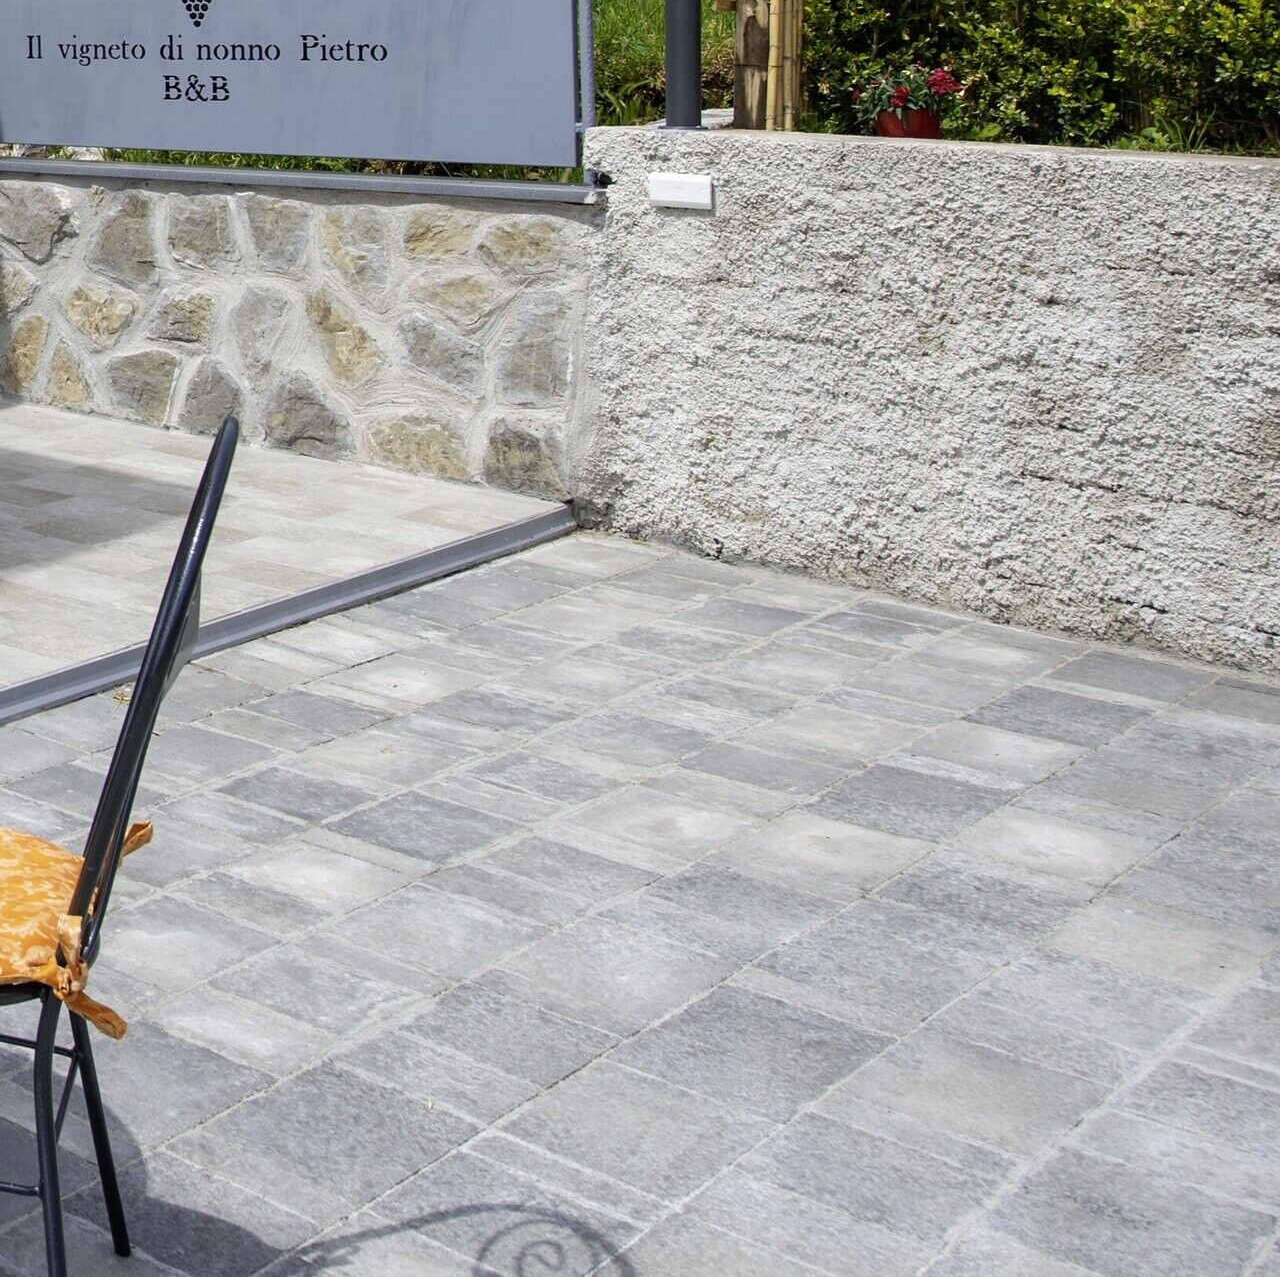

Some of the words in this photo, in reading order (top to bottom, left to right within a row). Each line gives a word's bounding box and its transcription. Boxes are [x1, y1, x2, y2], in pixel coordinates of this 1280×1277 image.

[26, 35, 43, 60] Il
[58, 34, 146, 67] vigneto
[159, 34, 184, 61] di
[196, 44, 281, 61] nonno
[300, 34, 388, 62] Pietro
[162, 74, 230, 102] B&B
